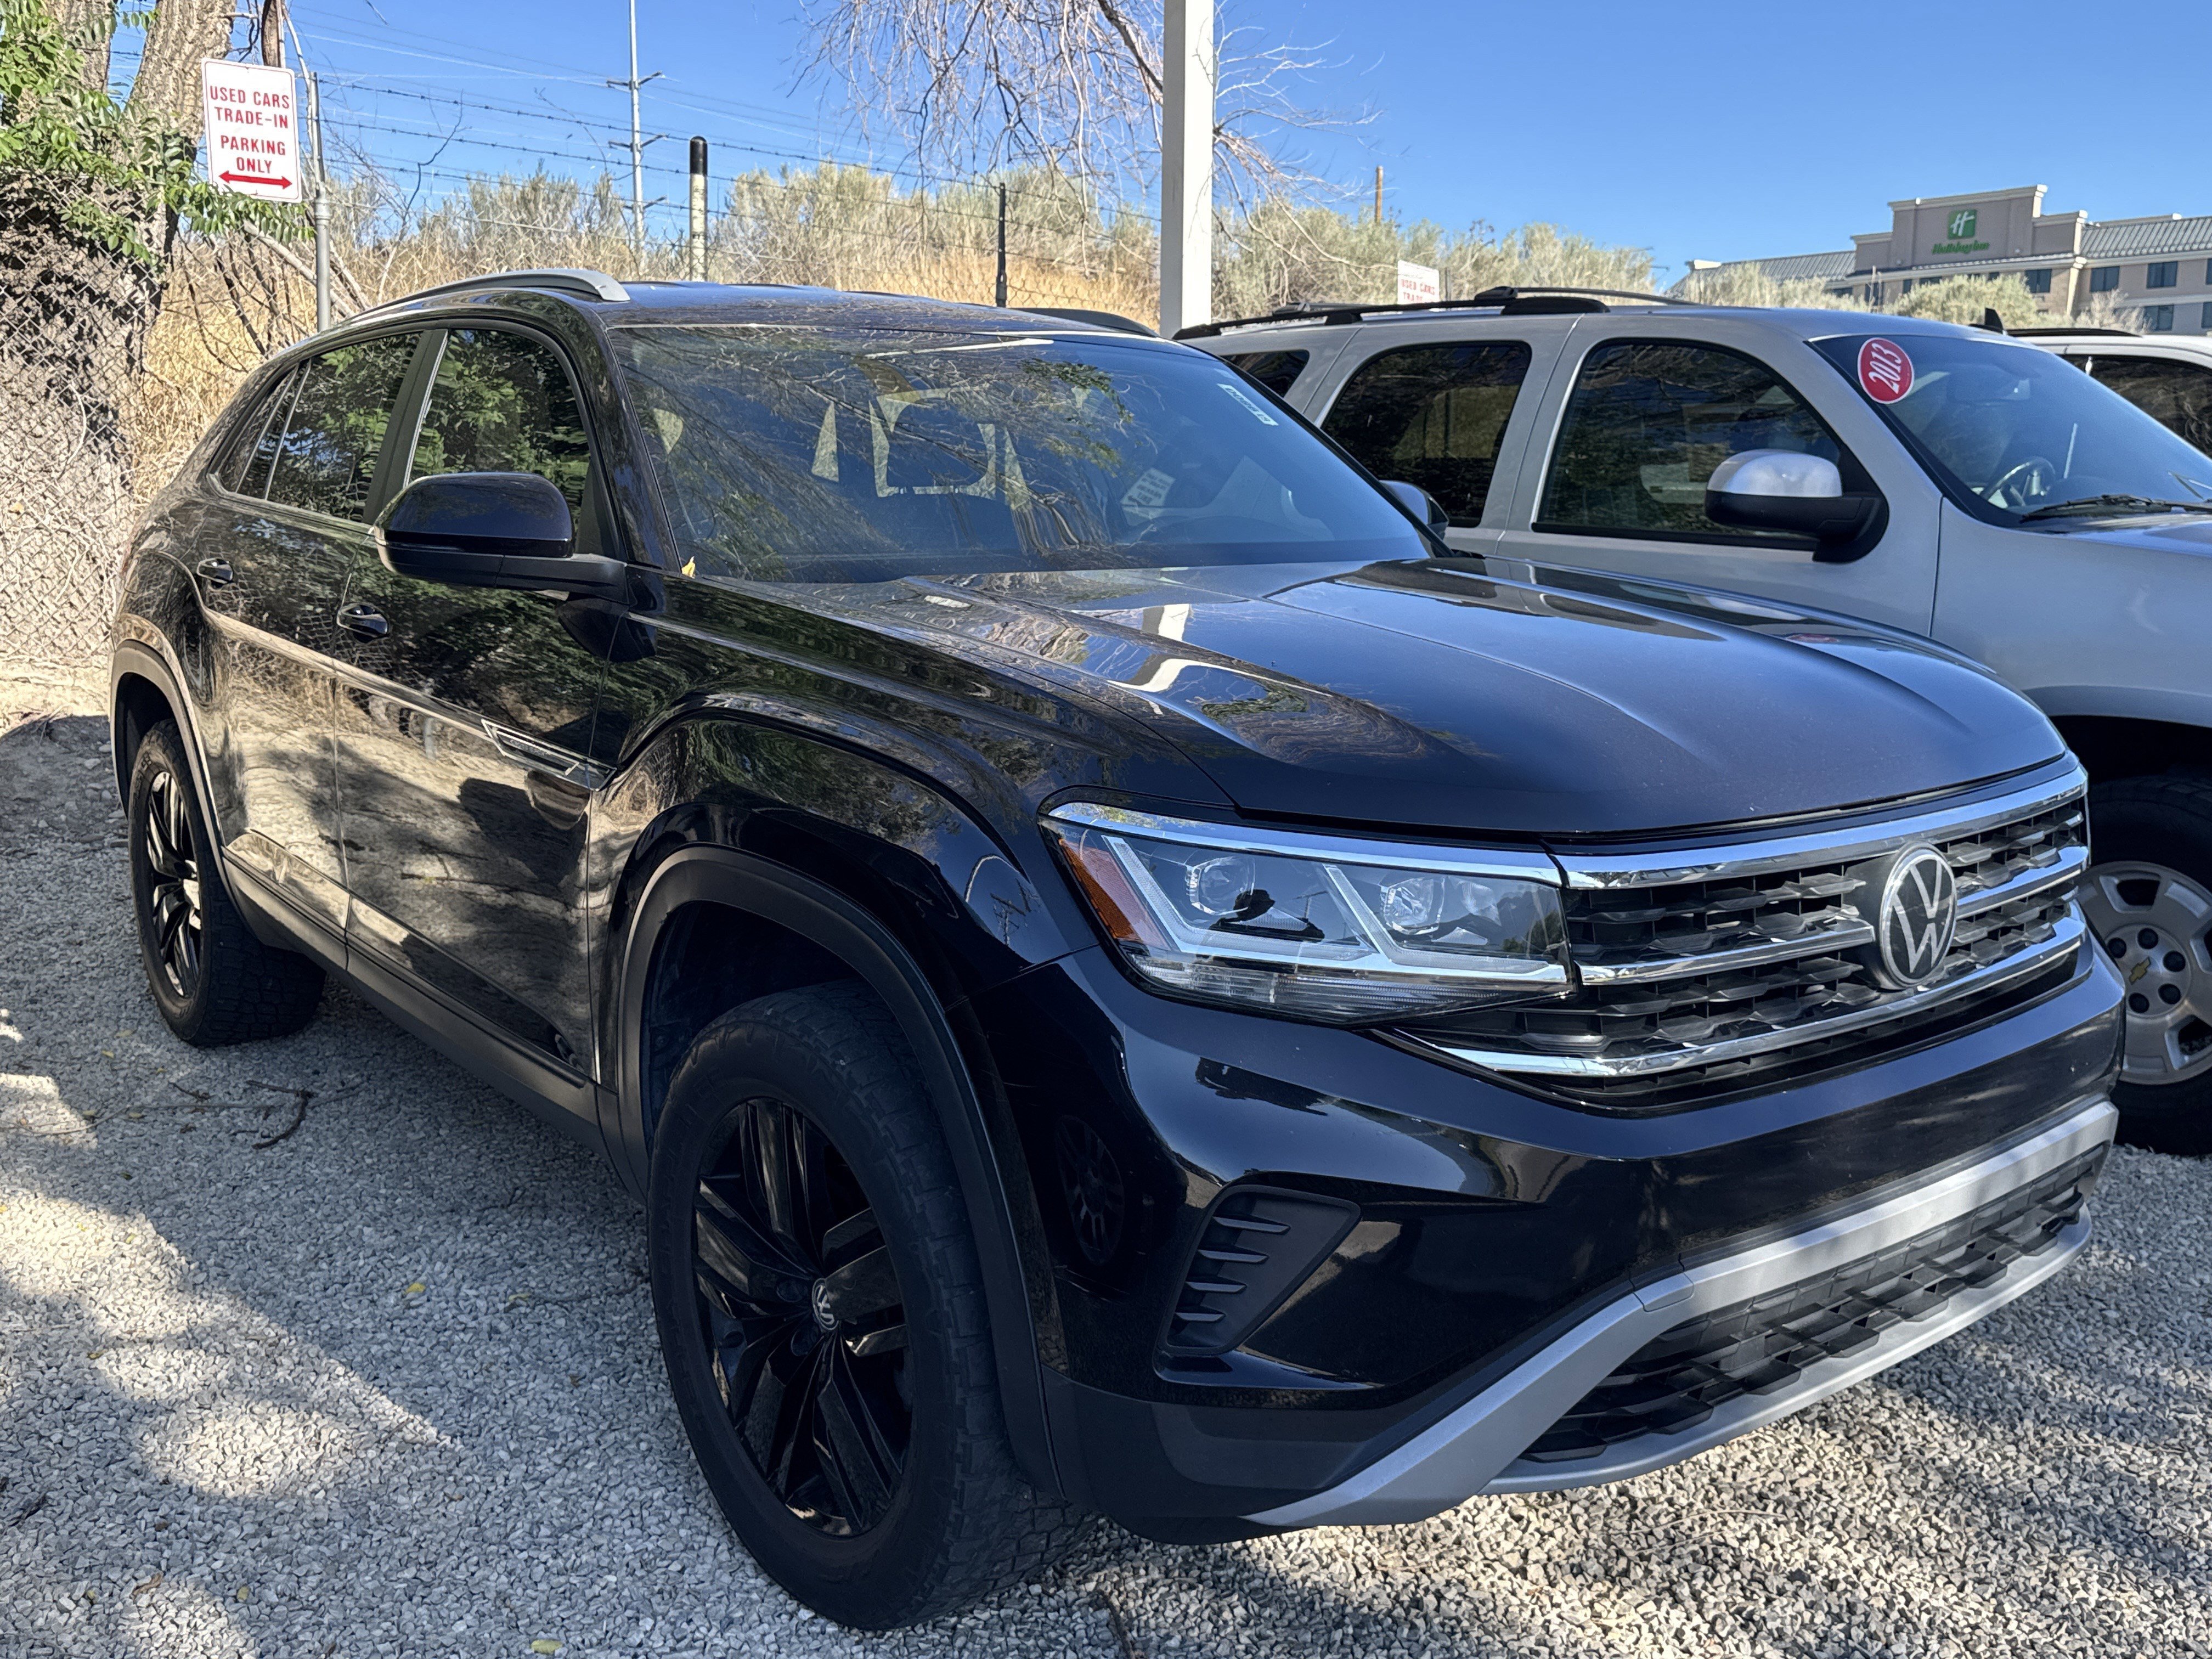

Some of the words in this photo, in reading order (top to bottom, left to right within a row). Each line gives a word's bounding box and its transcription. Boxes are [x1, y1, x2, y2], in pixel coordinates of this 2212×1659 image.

[210, 86, 245, 103] USED
[253, 92, 290, 109] CARS
[215, 106, 288, 128] TRADE-IN
[221, 135, 285, 155] PARKING
[236, 157, 272, 174] ONLY
[1868, 342, 1901, 394] 2013
